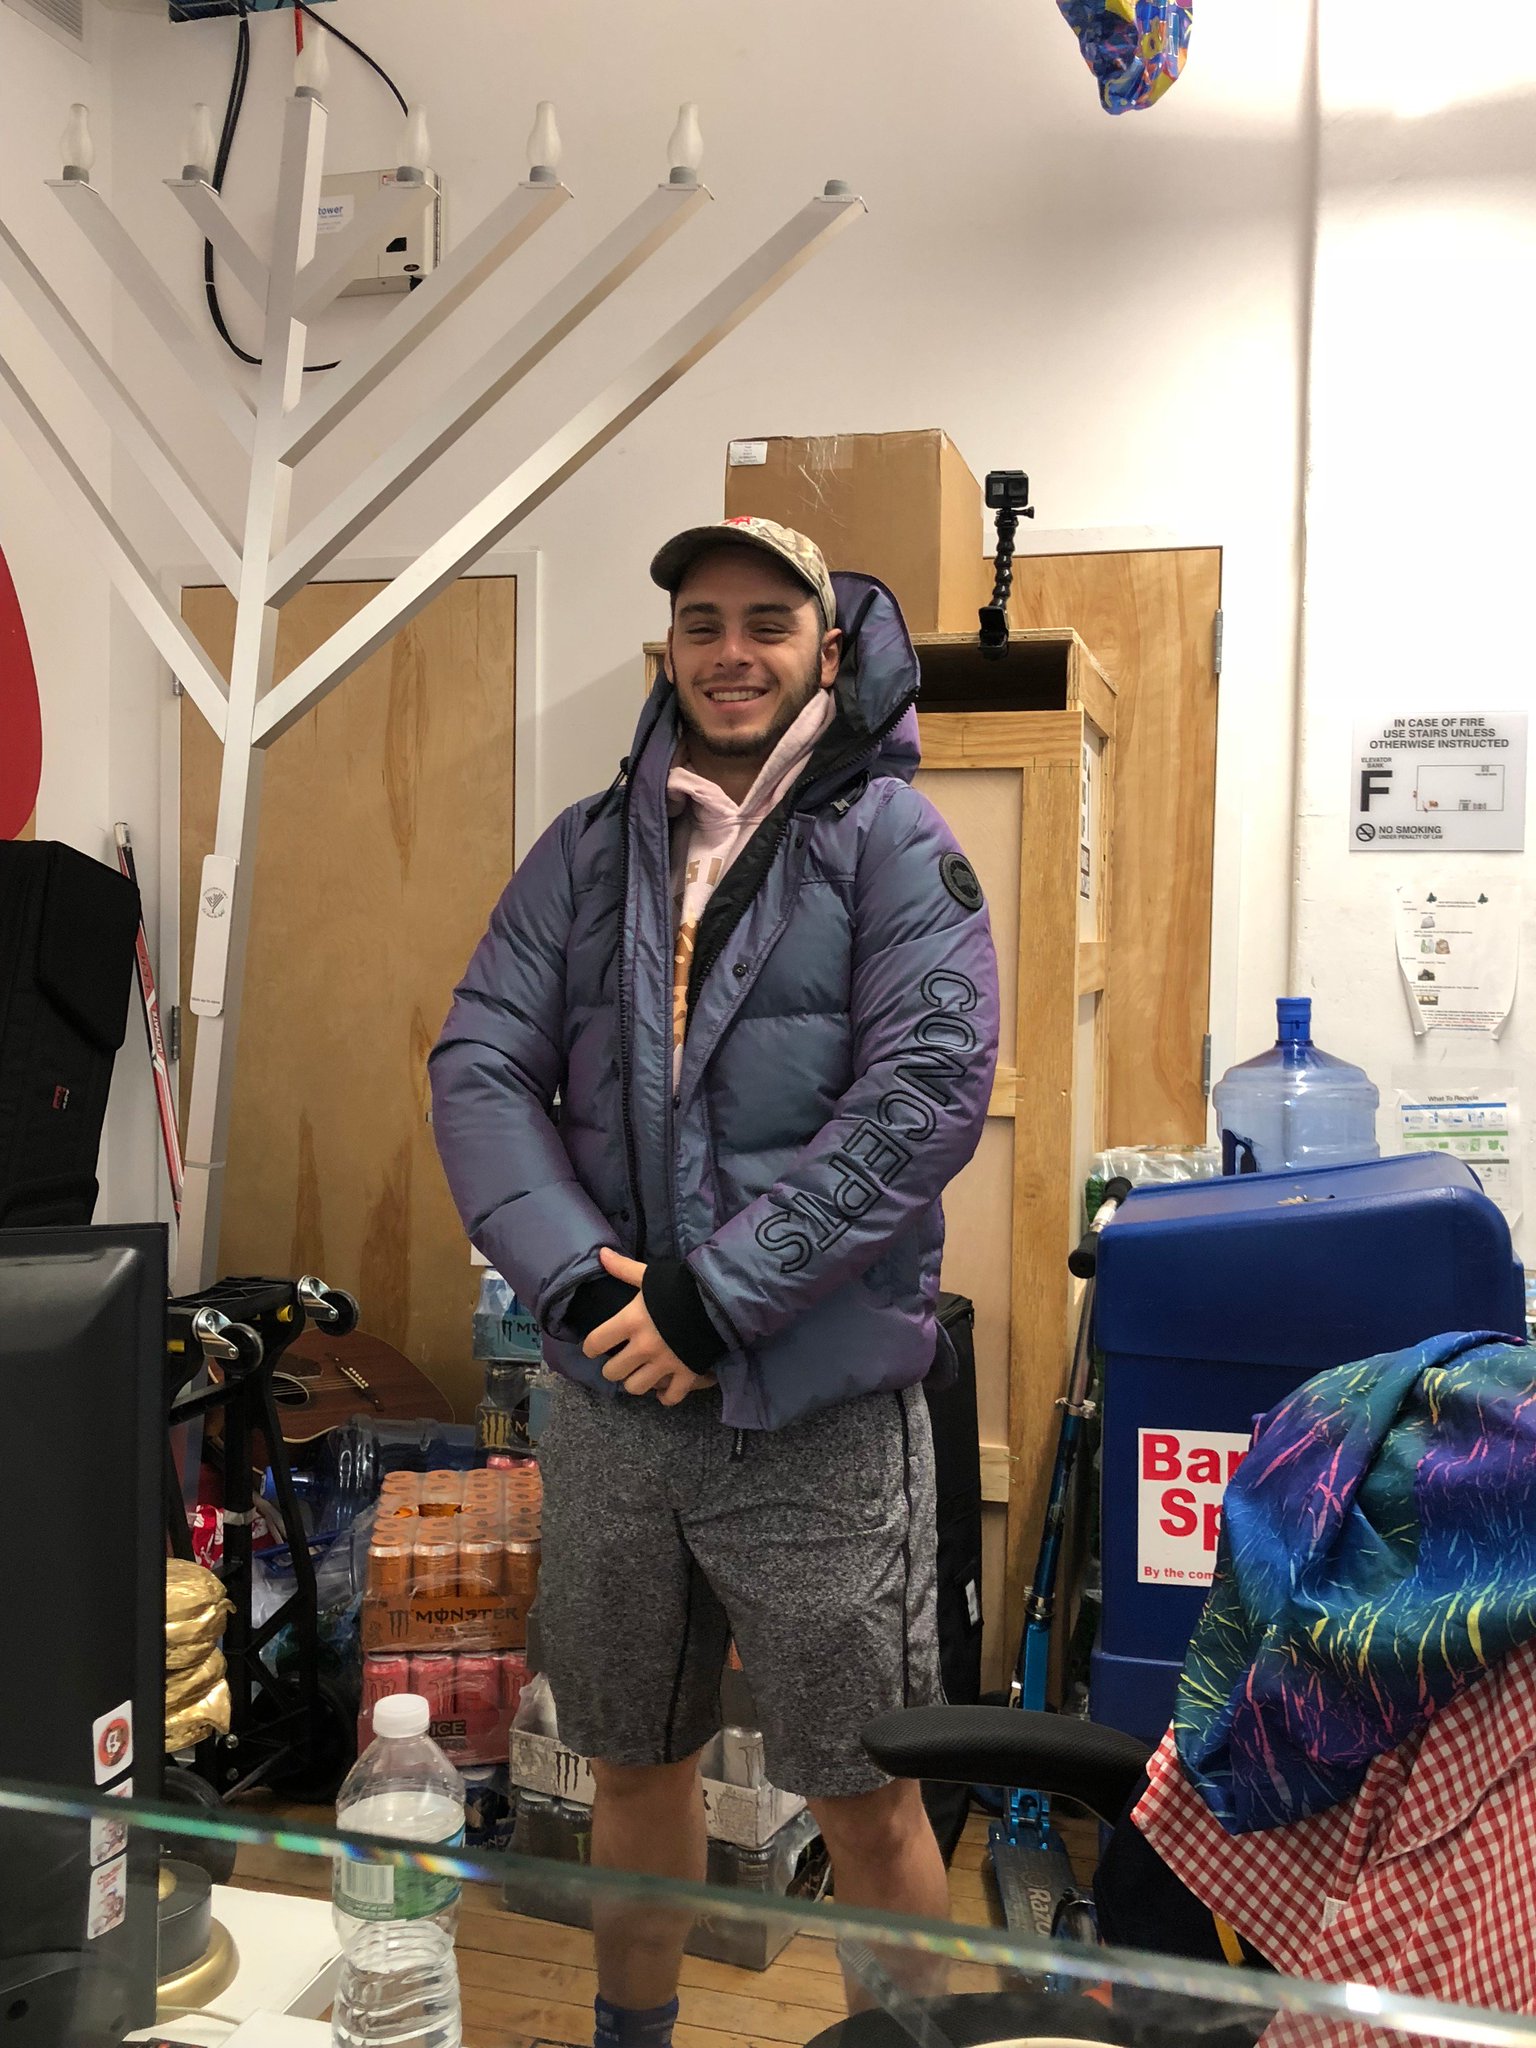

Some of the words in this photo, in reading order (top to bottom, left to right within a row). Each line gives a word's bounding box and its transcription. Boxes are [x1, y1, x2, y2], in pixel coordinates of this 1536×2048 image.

[1394, 719, 1405, 727] IN
[1408, 718, 1438, 727] CASE
[1441, 718, 1457, 727] OF
[1460, 718, 1485, 727] FIRE
[1383, 729, 1405, 738] USE
[1408, 729, 1448, 738] STAIRS
[1451, 728, 1496, 738] UNLESS
[1369, 740, 1435, 749] OTHERWISE
[1438, 739, 1509, 748] INSTRUCTED
[1360, 770, 1393, 812] F
[1378, 826, 1393, 834] NO
[1396, 826, 1442, 834] SMOKING
[152, 1010, 163, 1053] ULTIMATE
[755, 969, 978, 1275] CONCEPTS
[1144, 1566, 1160, 1579] By
[1164, 1568, 1185, 1579] the
[415, 1607, 520, 1624] MONSTER
[429, 1720, 466, 1737] ICE
